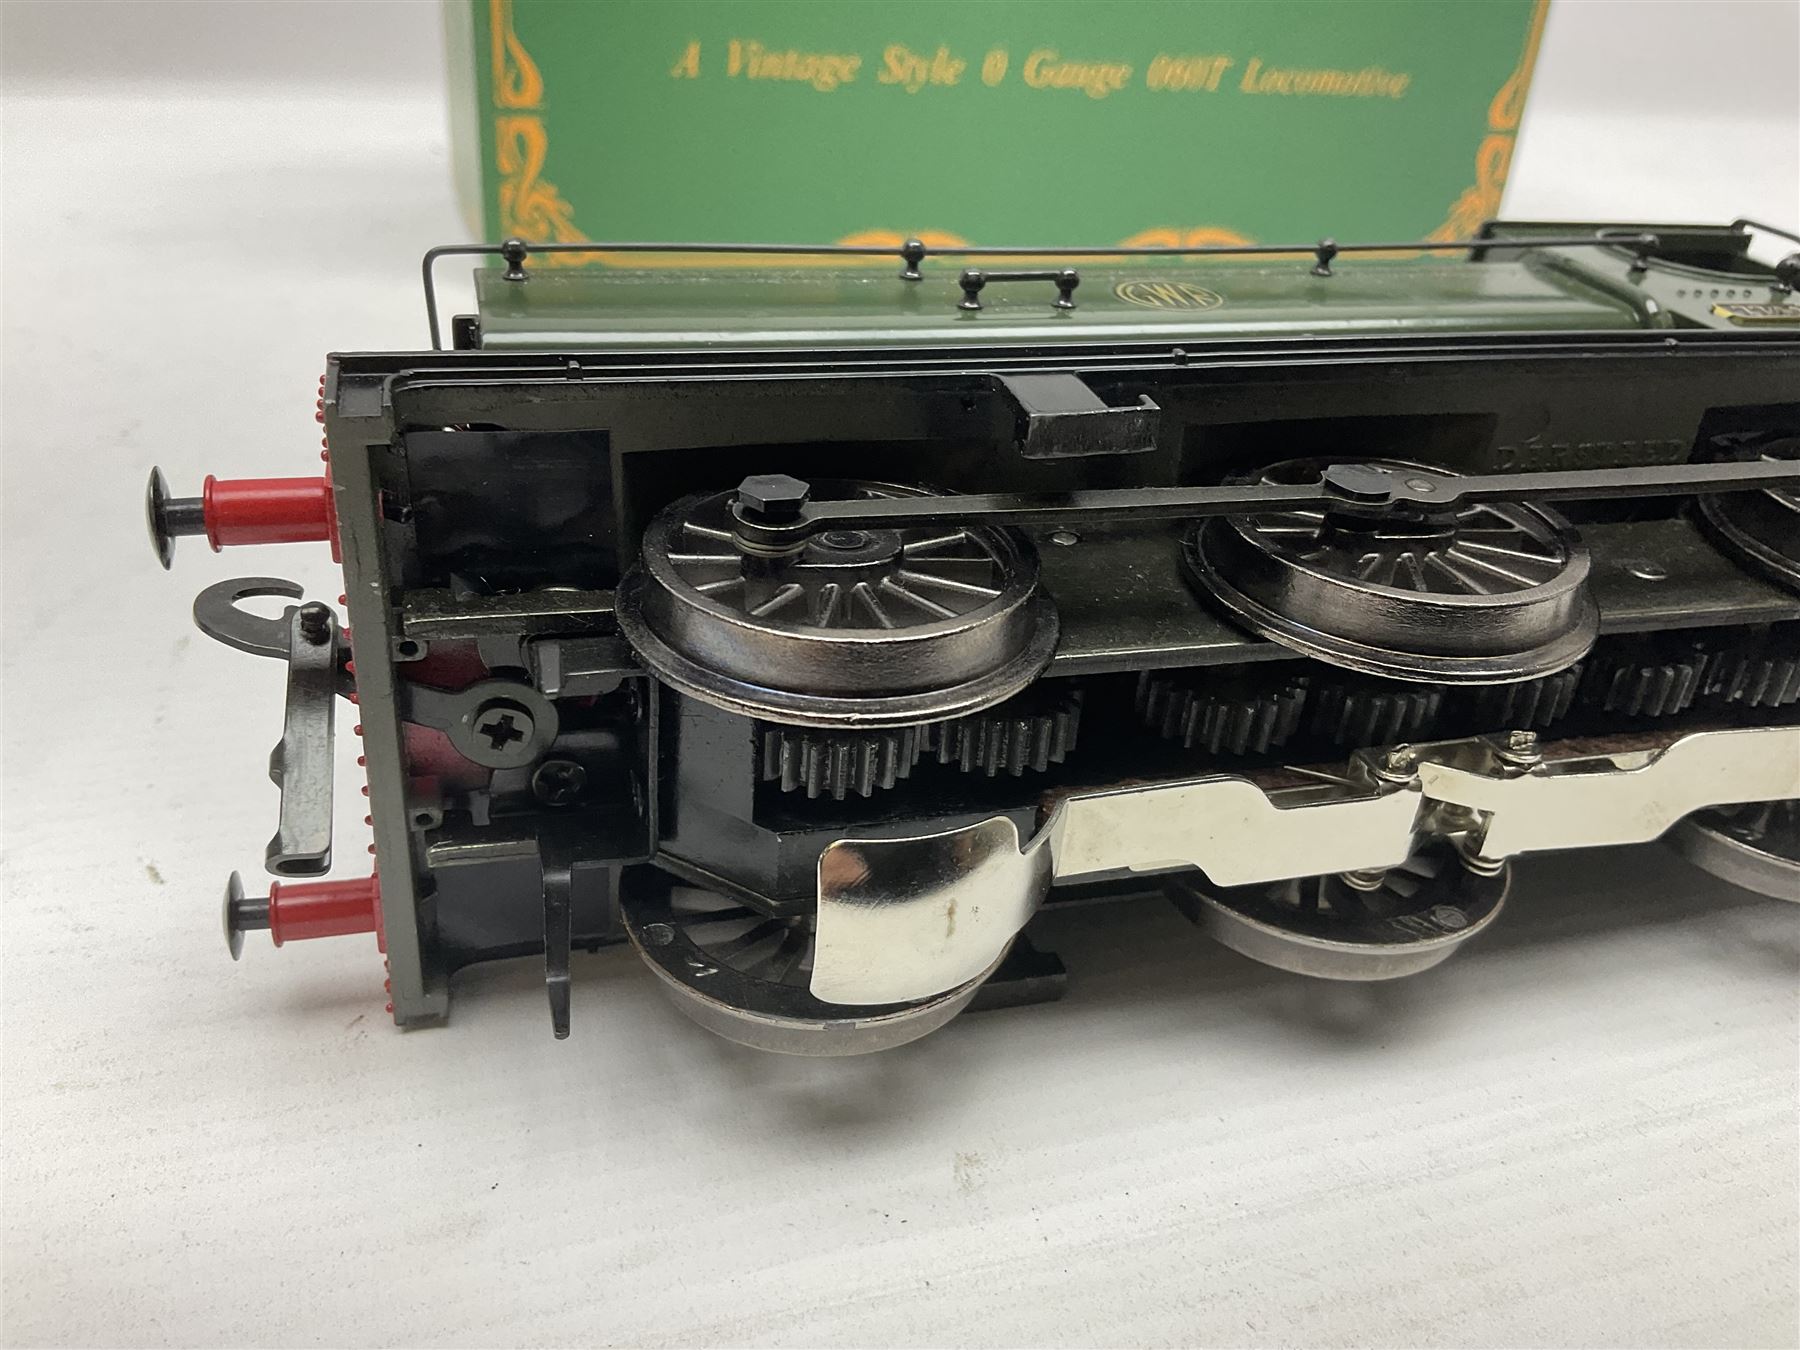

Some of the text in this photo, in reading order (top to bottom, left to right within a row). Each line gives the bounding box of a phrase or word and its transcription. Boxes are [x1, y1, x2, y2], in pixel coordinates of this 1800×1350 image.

[672, 41, 700, 79] A
[727, 40, 862, 91] Vintage
[879, 44, 966, 92] Style
[1023, 50, 1132, 98] Gauge
[1240, 57, 1410, 99] Locomotive
[1124, 282, 1214, 307] GWR
